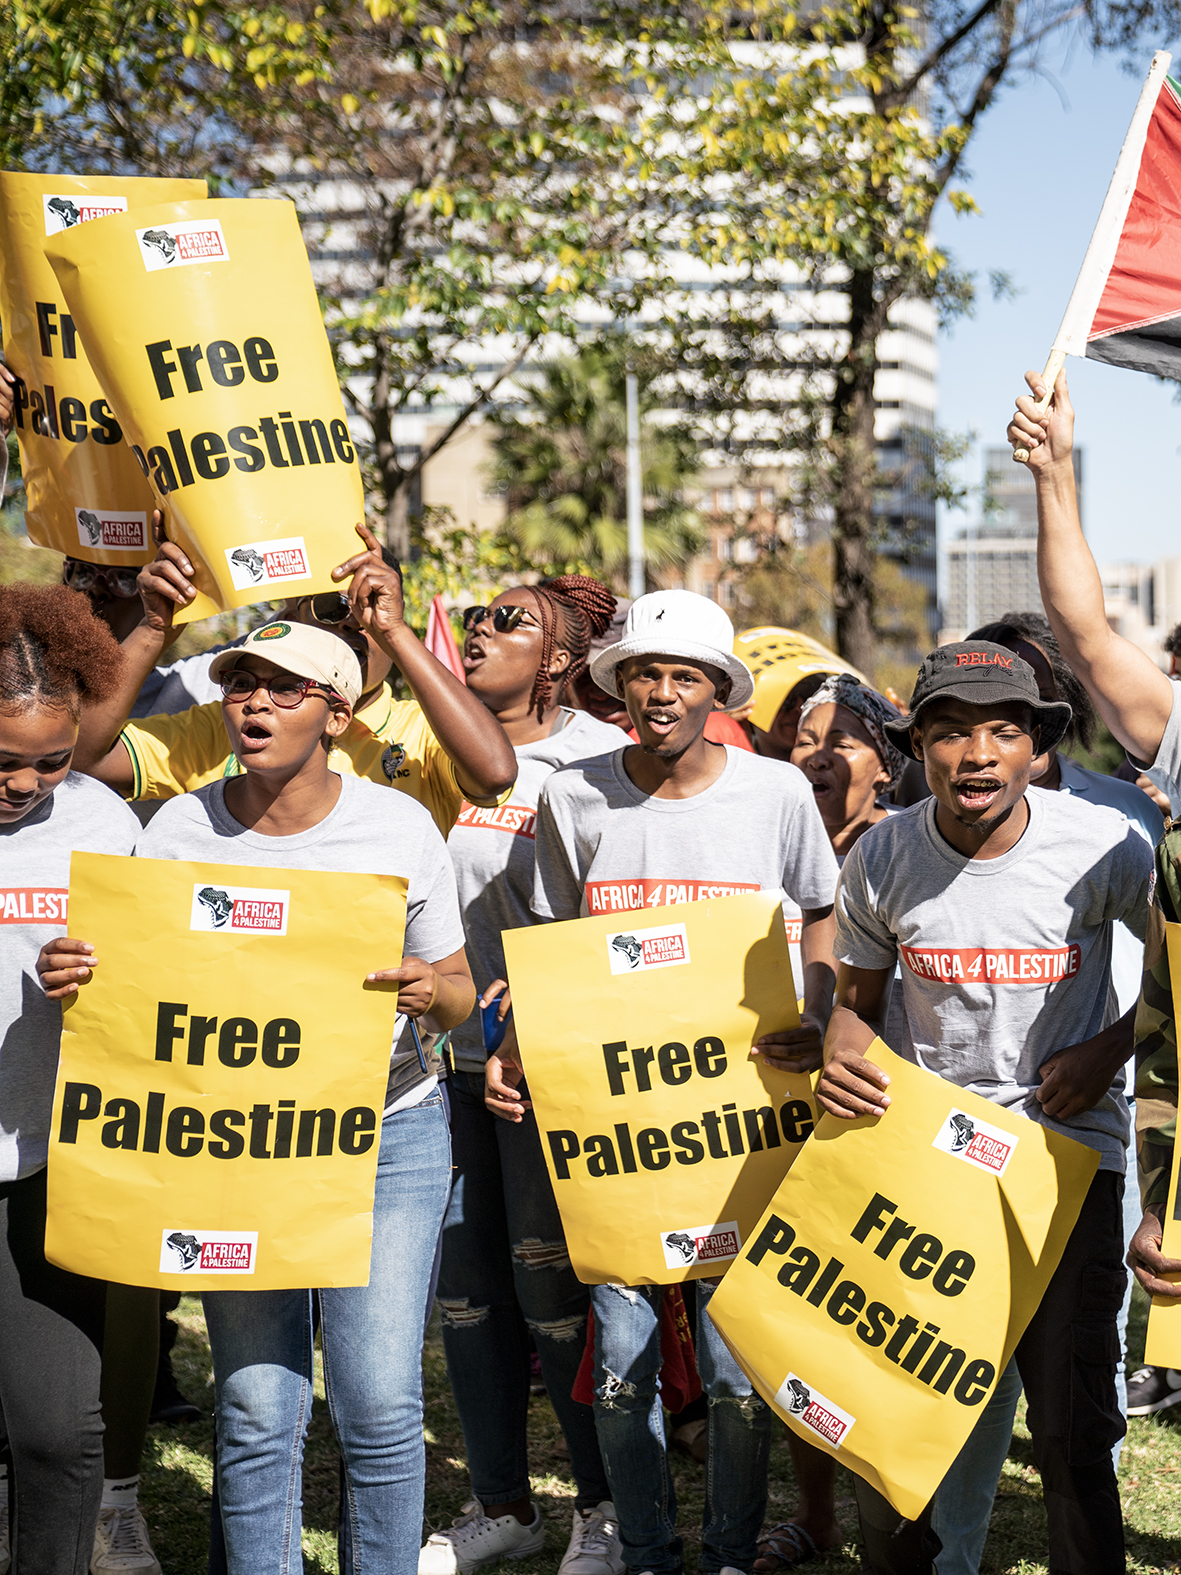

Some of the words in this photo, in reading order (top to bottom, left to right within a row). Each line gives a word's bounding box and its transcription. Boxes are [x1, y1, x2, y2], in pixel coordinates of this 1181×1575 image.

[179, 231, 220, 250] AFRICA
[181, 249, 187, 258] 4
[187, 245, 223, 258] PALESTINE
[36, 301, 78, 360] Fr
[146, 337, 279, 400] Free
[13, 376, 123, 445] Pales
[134, 411, 354, 499] Palestine
[103, 522, 141, 536] AFRICA
[108, 535, 142, 545] PALESTINE
[266, 549, 303, 567] AFRICA
[268, 566, 274, 576] 4
[274, 563, 306, 576] PALESTINE
[955, 652, 1013, 669] RELAY
[458, 805, 477, 823] 4
[472, 807, 537, 835] PALESTI
[0, 892, 70, 920] ALEST
[234, 901, 280, 919] AFRICA
[592, 884, 644, 911] AFRICA
[646, 884, 662, 908] 4
[234, 916, 240, 926] 4
[240, 916, 280, 928] PALESTINE
[644, 936, 683, 955] AFRICA
[645, 954, 650, 963] 4
[650, 950, 684, 963] PALESTINE
[907, 951, 965, 979] AFRICA
[967, 953, 983, 978] 4
[985, 950, 1078, 979] PALESTINE
[155, 1001, 300, 1069] Free
[602, 1035, 727, 1097] Free
[58, 1081, 376, 1160] Palestine
[547, 1099, 814, 1180] Palestine
[971, 1134, 1008, 1161] AFRICA
[967, 1147, 973, 1156] 4
[972, 1149, 1004, 1170] PALESTINE
[203, 1244, 249, 1259] AFRICA
[698, 1232, 736, 1251] AFRICA
[704, 1244, 738, 1258] PALESTINE
[850, 1192, 976, 1297] Free
[202, 1258, 208, 1267] 4
[208, 1258, 248, 1268] PALESTINE
[744, 1213, 996, 1407] Palestine
[808, 1404, 844, 1436] AFRICA
[808, 1416, 839, 1442] PALESTINE
